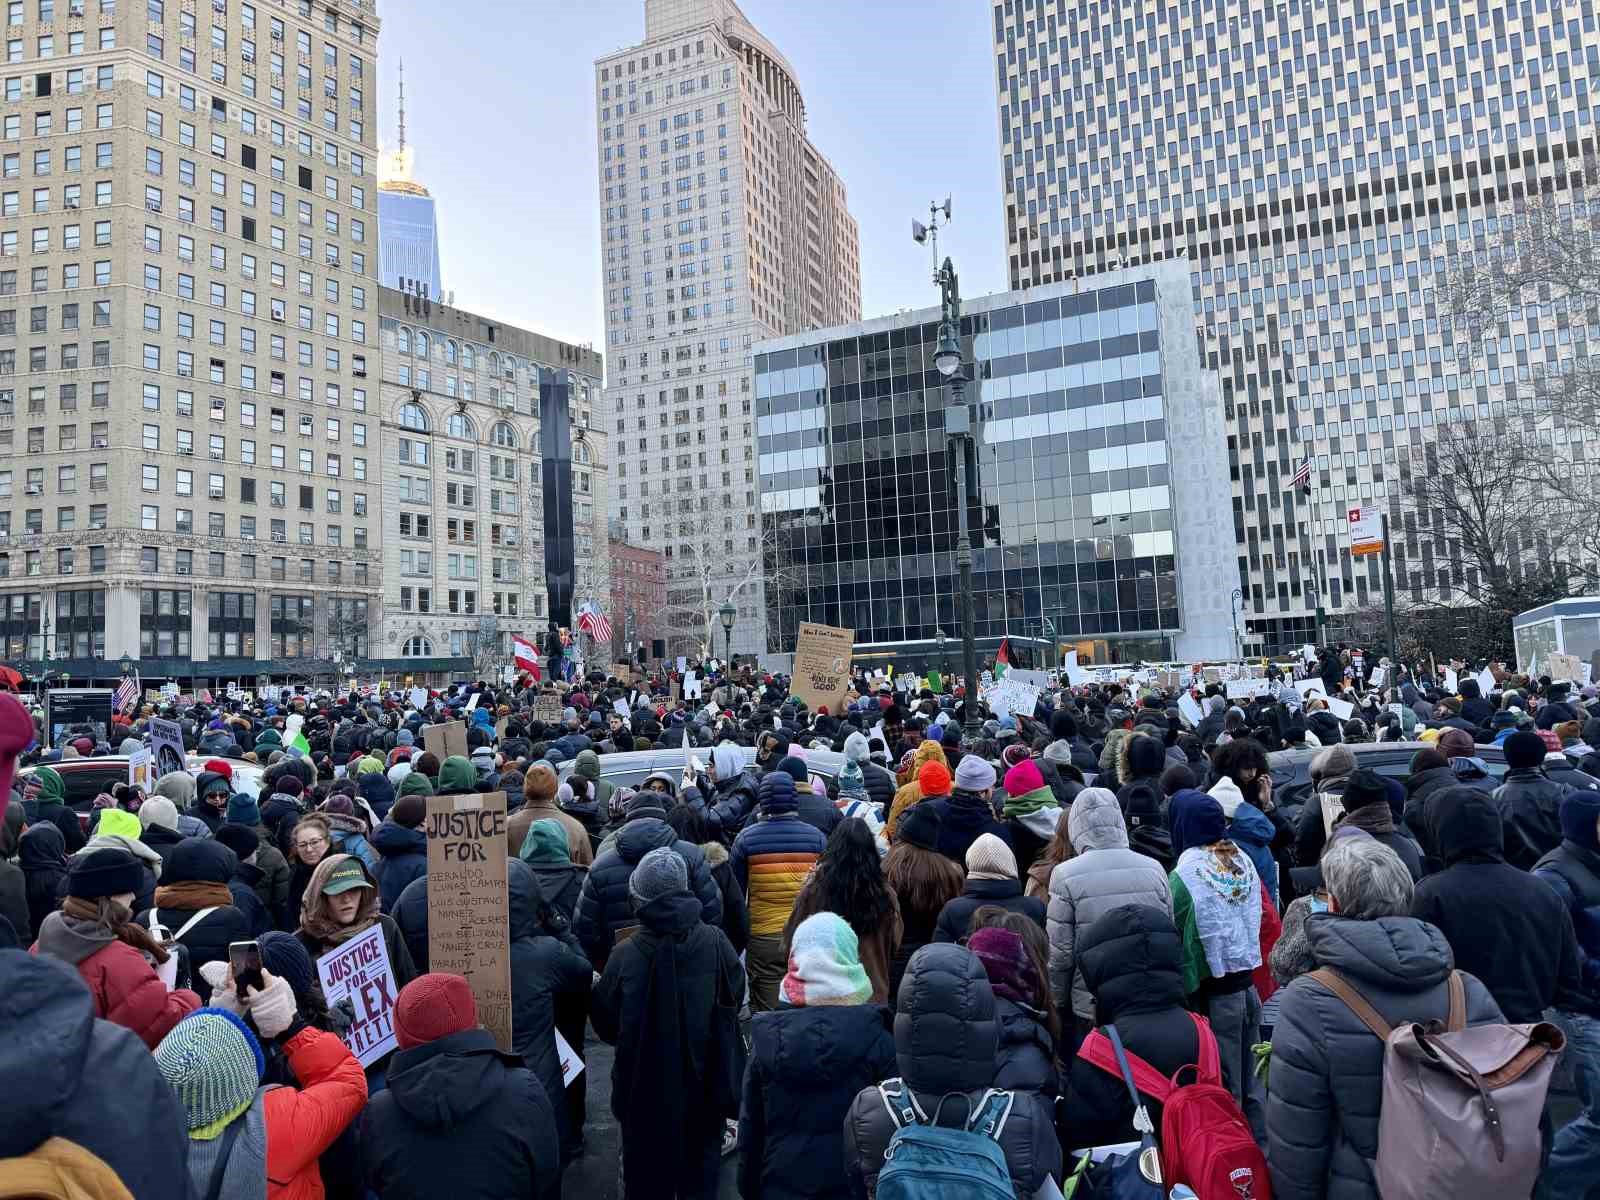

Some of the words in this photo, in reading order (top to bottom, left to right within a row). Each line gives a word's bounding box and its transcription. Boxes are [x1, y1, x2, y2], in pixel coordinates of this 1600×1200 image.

[427, 809, 506, 839] JUSTICE
[444, 842, 487, 862] FOR
[327, 937, 382, 987] JUSTICE
[345, 970, 369, 993] FOR
[345, 973, 394, 1035] LEX
